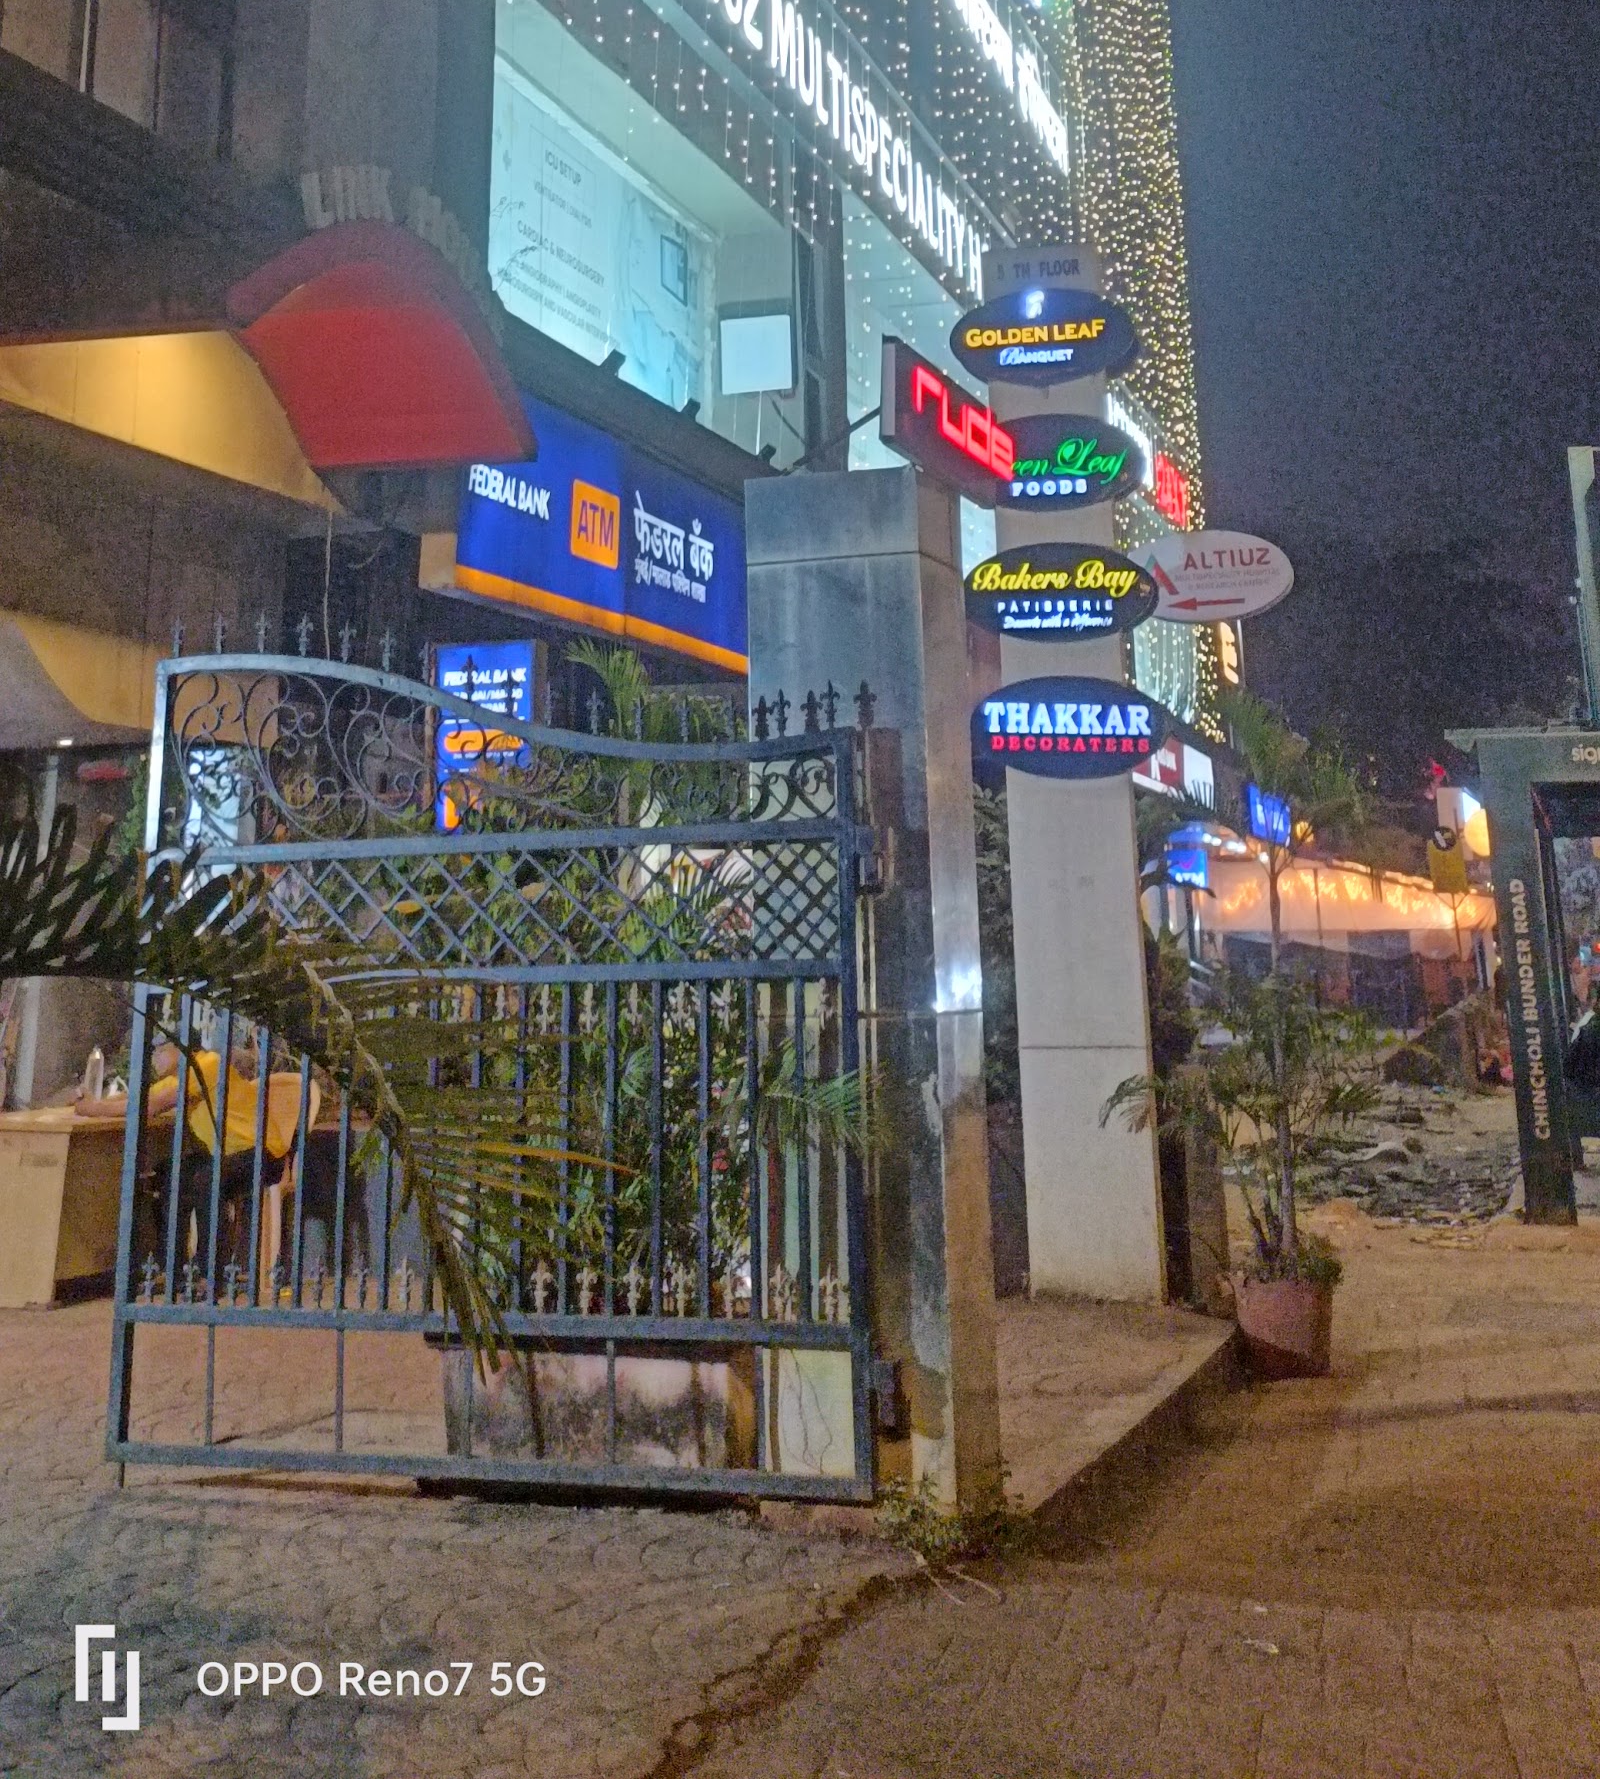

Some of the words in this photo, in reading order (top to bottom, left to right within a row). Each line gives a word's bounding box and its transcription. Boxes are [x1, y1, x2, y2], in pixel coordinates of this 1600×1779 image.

[965, 325, 1049, 348] GOLDEN
[1053, 318, 1106, 341] LEAF
[468, 463, 517, 508] FEDERAL
[518, 480, 550, 521] BANK
[1011, 478, 1088, 497] FOODS
[577, 499, 615, 551] ATM
[633, 490, 686, 570] फेडरल
[973, 562, 1072, 591] Bakers
[1075, 559, 1139, 598] Bay
[1184, 547, 1272, 571] ALTIUZ
[983, 701, 1151, 736] THAKKAR
[990, 735, 1150, 753] DECORATERS
[1509, 878, 1529, 934] ROAD
[1516, 938, 1539, 1021] BUNDER
[1526, 1026, 1551, 1140] CHINCHOLI
